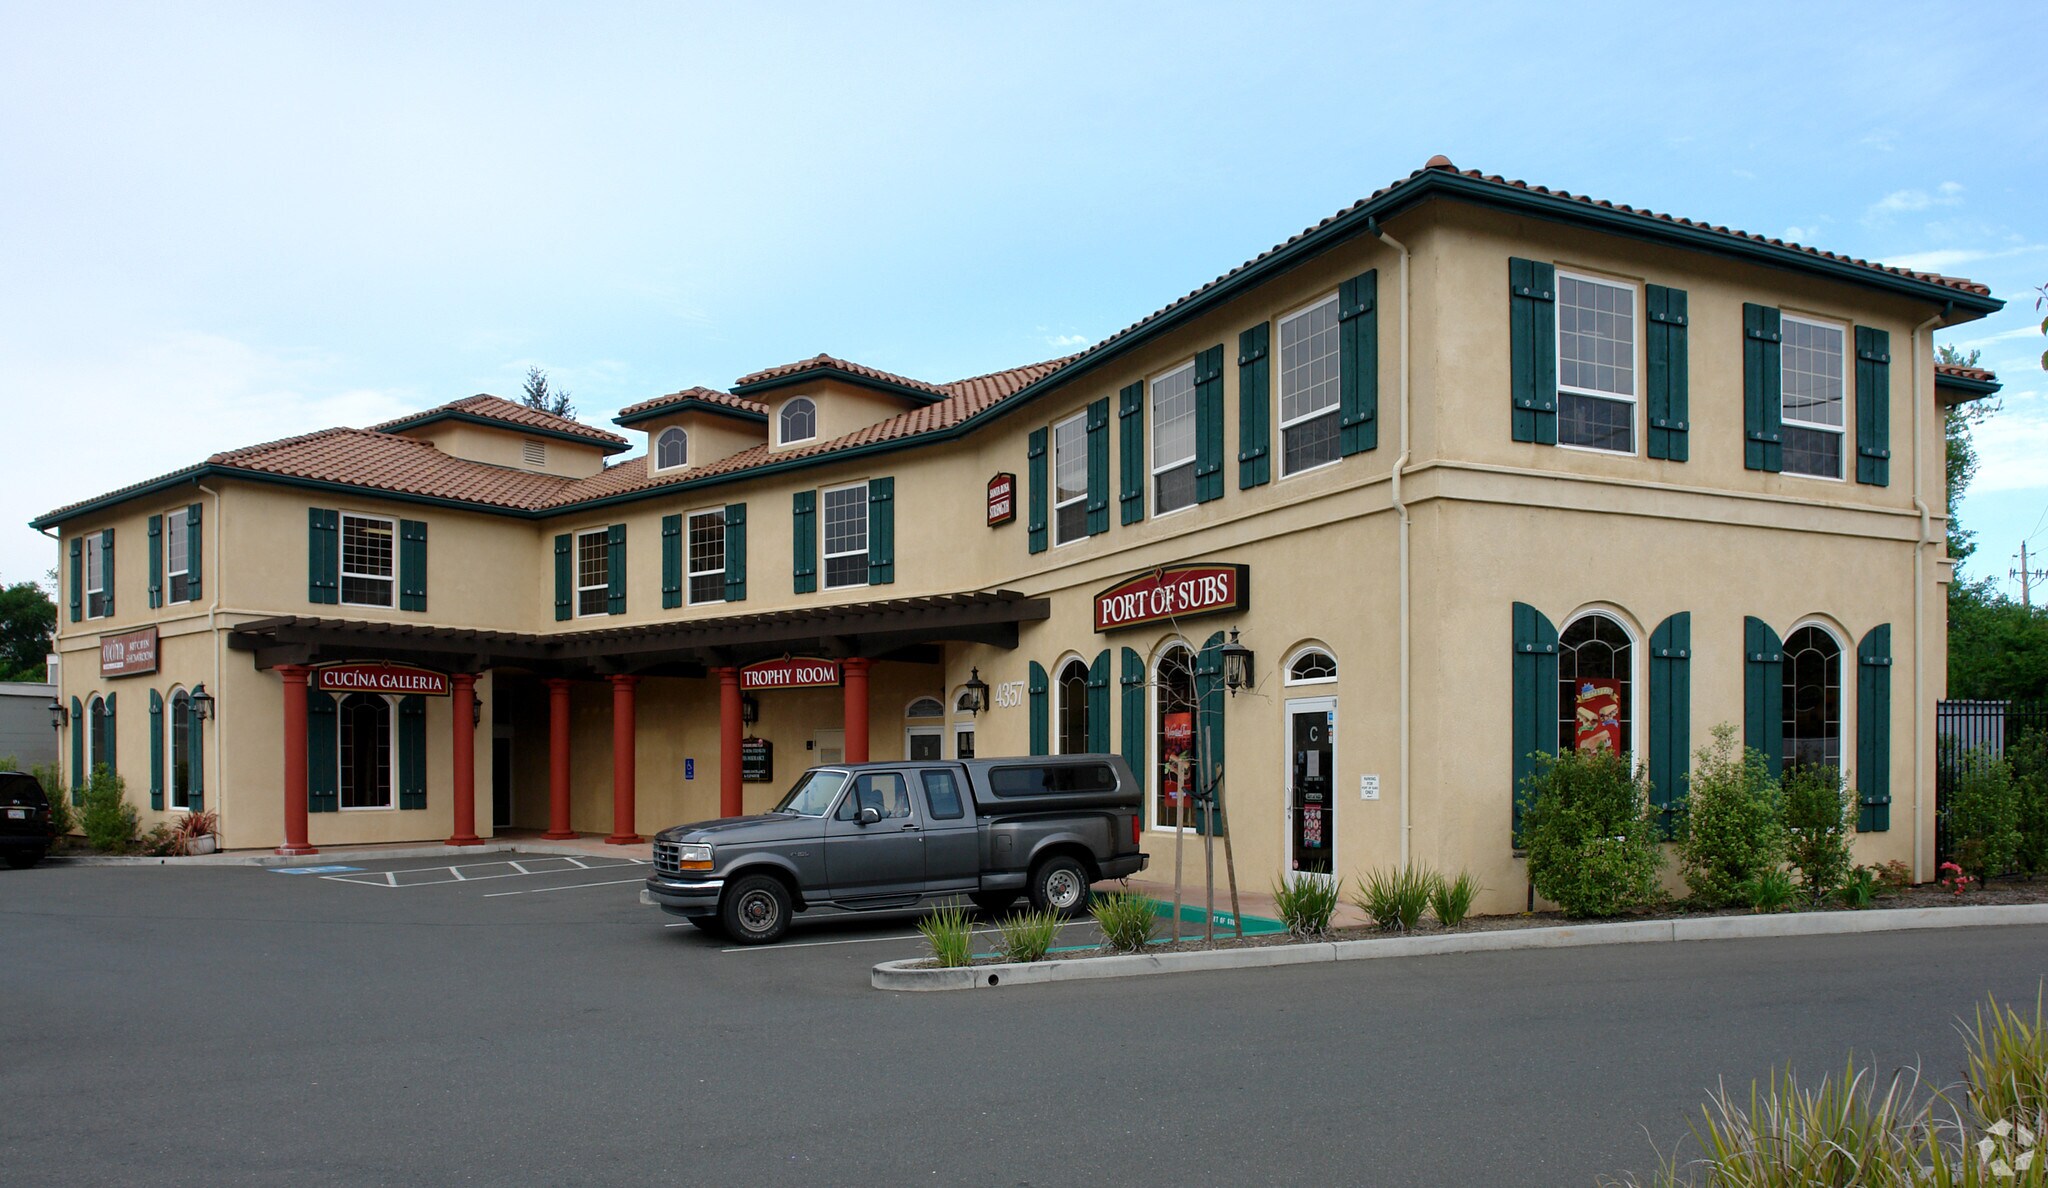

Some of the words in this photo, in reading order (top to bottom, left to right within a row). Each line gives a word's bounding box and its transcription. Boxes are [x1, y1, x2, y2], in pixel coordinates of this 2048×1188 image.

[1101, 589, 1149, 624] PORT
[1150, 584, 1176, 615] OF
[1178, 573, 1228, 610] SUBS
[126, 651, 154, 663] SHOWROOM
[323, 669, 378, 688] CUCÍNA
[379, 674, 442, 690] GALLERIA
[743, 668, 792, 686] TROPHY
[796, 666, 835, 683] ROOM
[995, 680, 1025, 707] 4357
[1309, 726, 1319, 742] C
